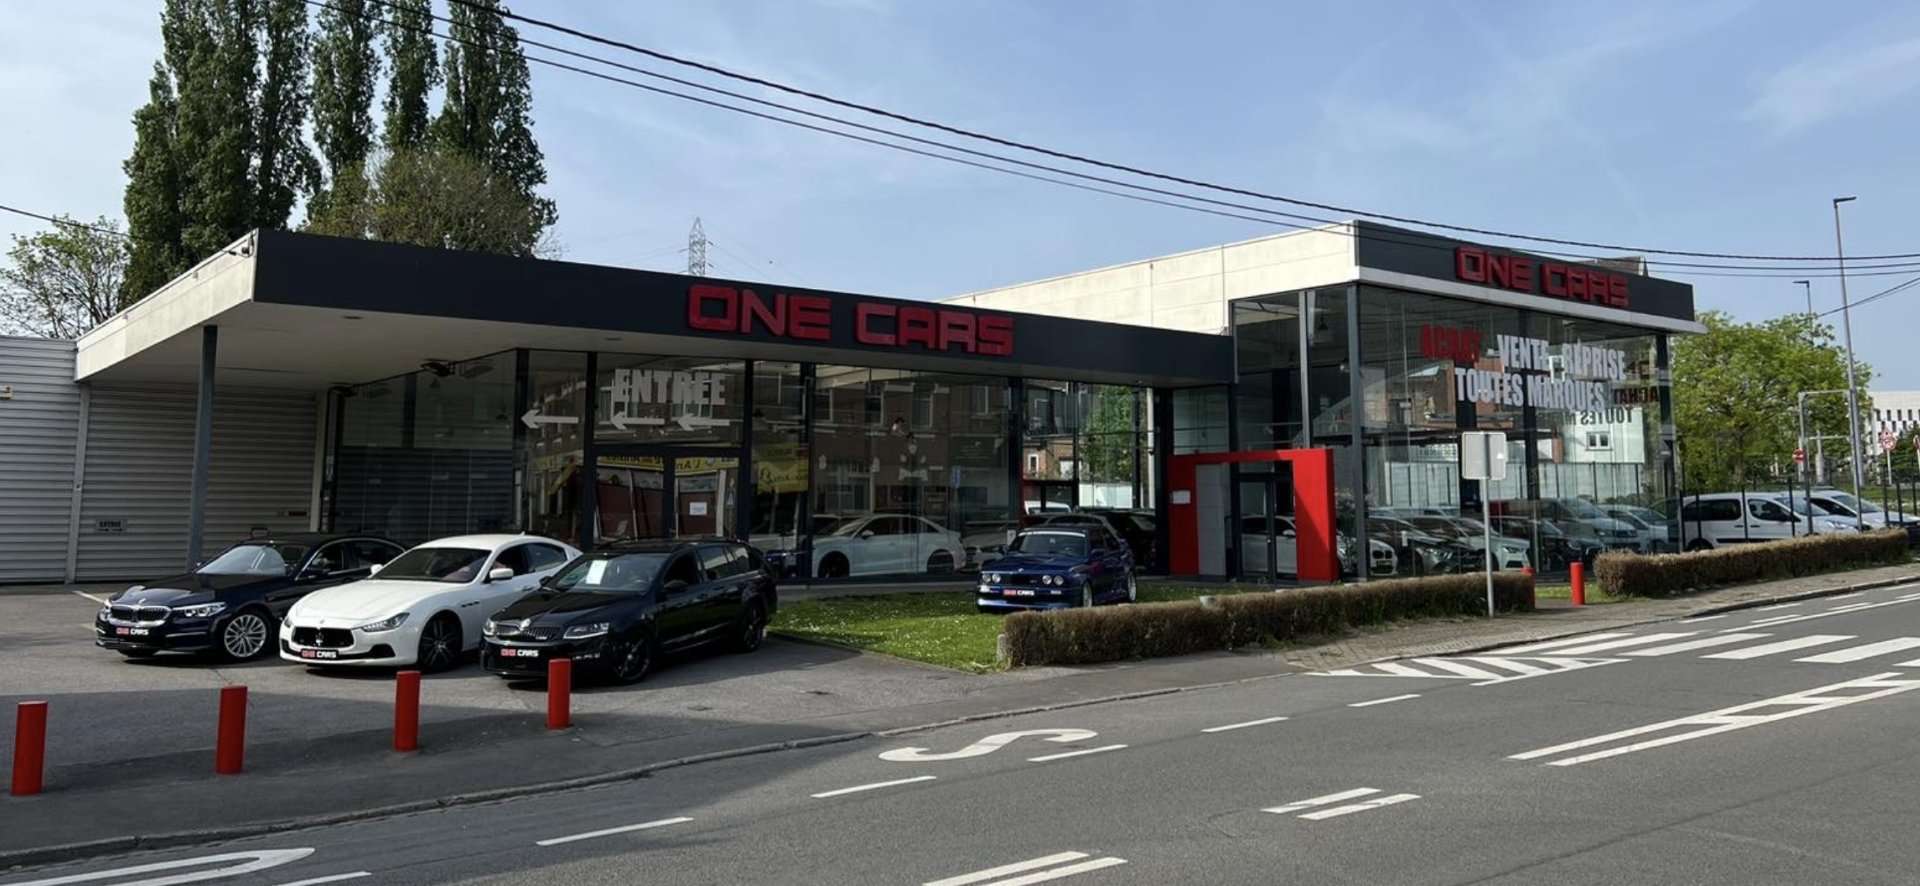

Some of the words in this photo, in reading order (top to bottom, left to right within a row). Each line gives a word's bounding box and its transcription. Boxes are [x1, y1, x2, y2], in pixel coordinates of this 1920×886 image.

[1457, 245, 1534, 293] ONE
[1541, 262, 1630, 308] CARS
[688, 283, 832, 341] ONE
[856, 302, 1014, 356] CARS
[1497, 334, 1550, 371] VENTE
[1454, 367, 1524, 407] TOUTES
[1527, 374, 1605, 414] MARQUES
[517, 649, 539, 657] CARS
